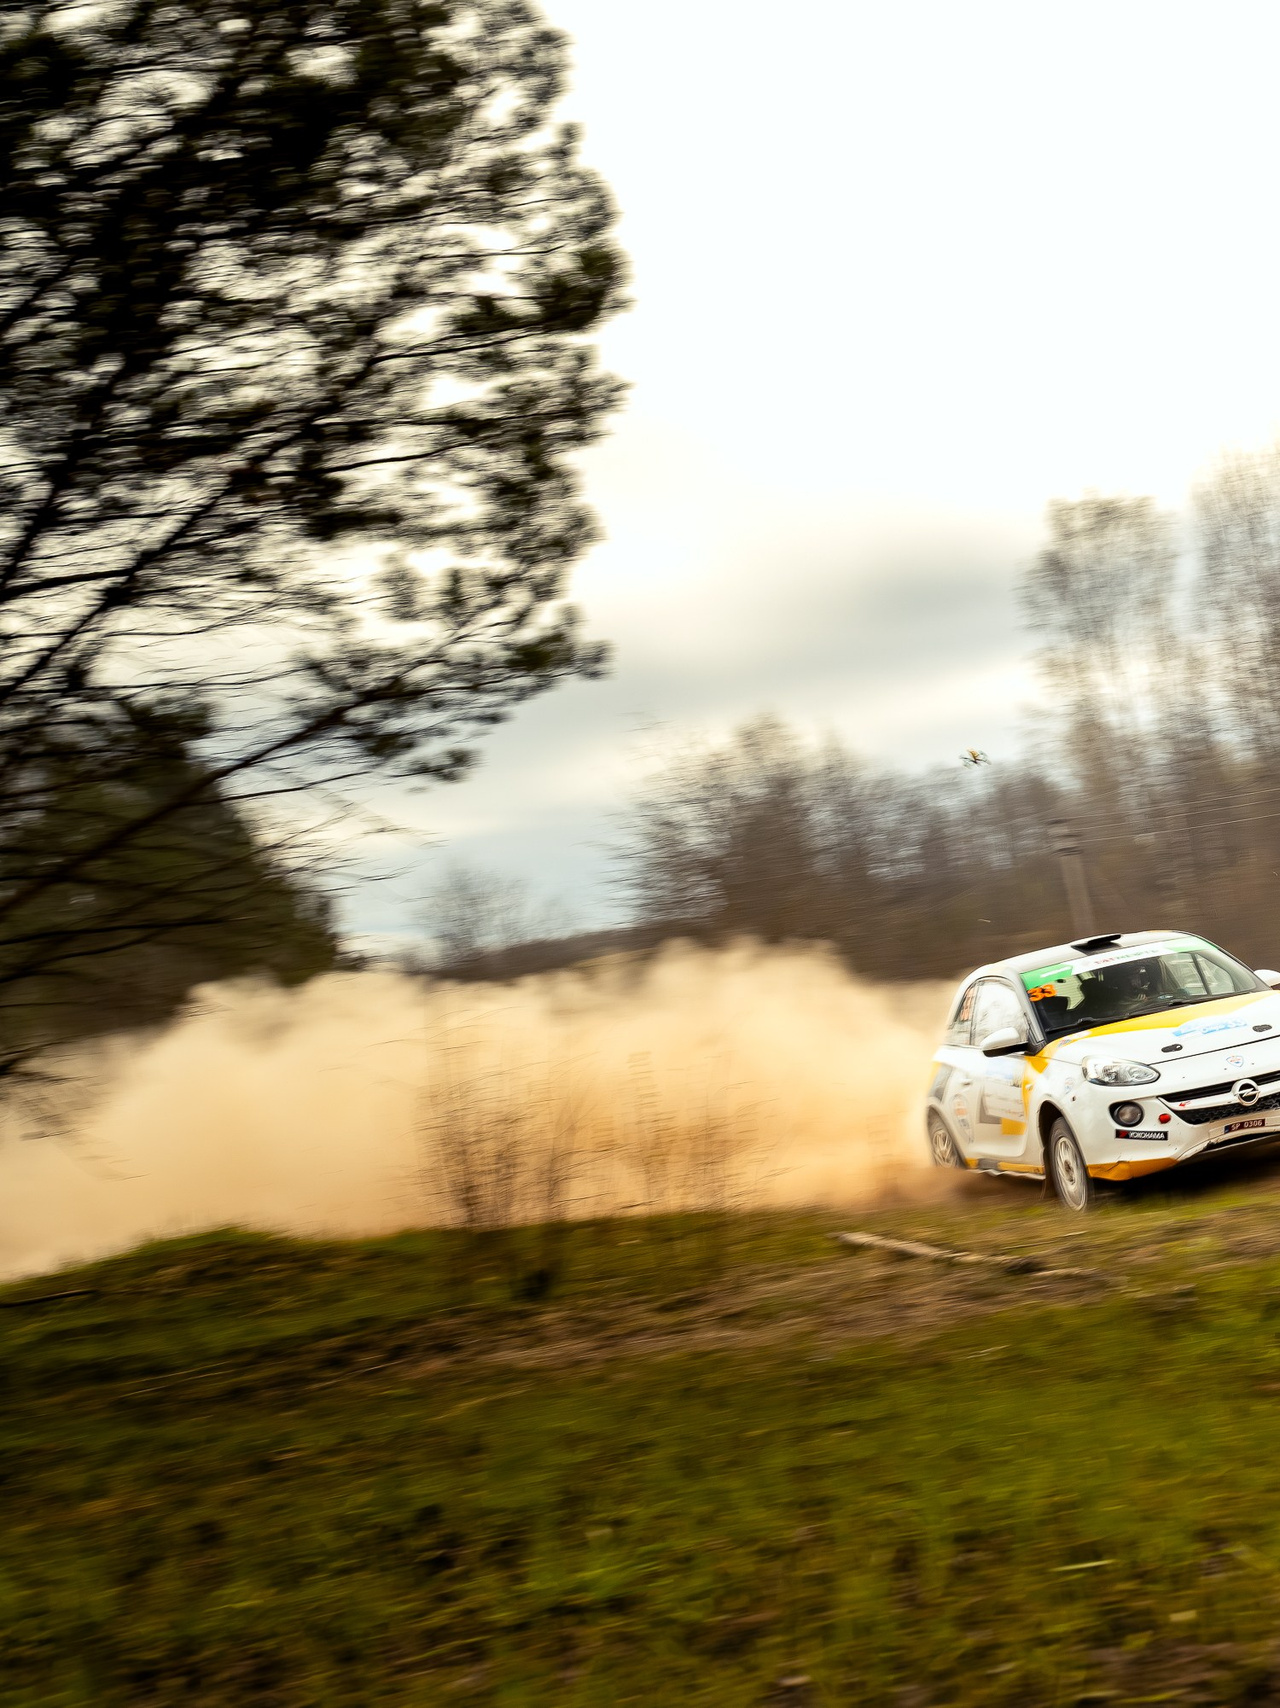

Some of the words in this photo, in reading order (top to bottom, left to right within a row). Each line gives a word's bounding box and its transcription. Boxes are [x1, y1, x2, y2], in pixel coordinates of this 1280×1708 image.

[1027, 984, 1056, 1002] 33
[1231, 1122, 1241, 1131] SP
[1243, 1119, 1263, 1128] 0306
[1128, 1131, 1165, 1140] YOKOHAMA
